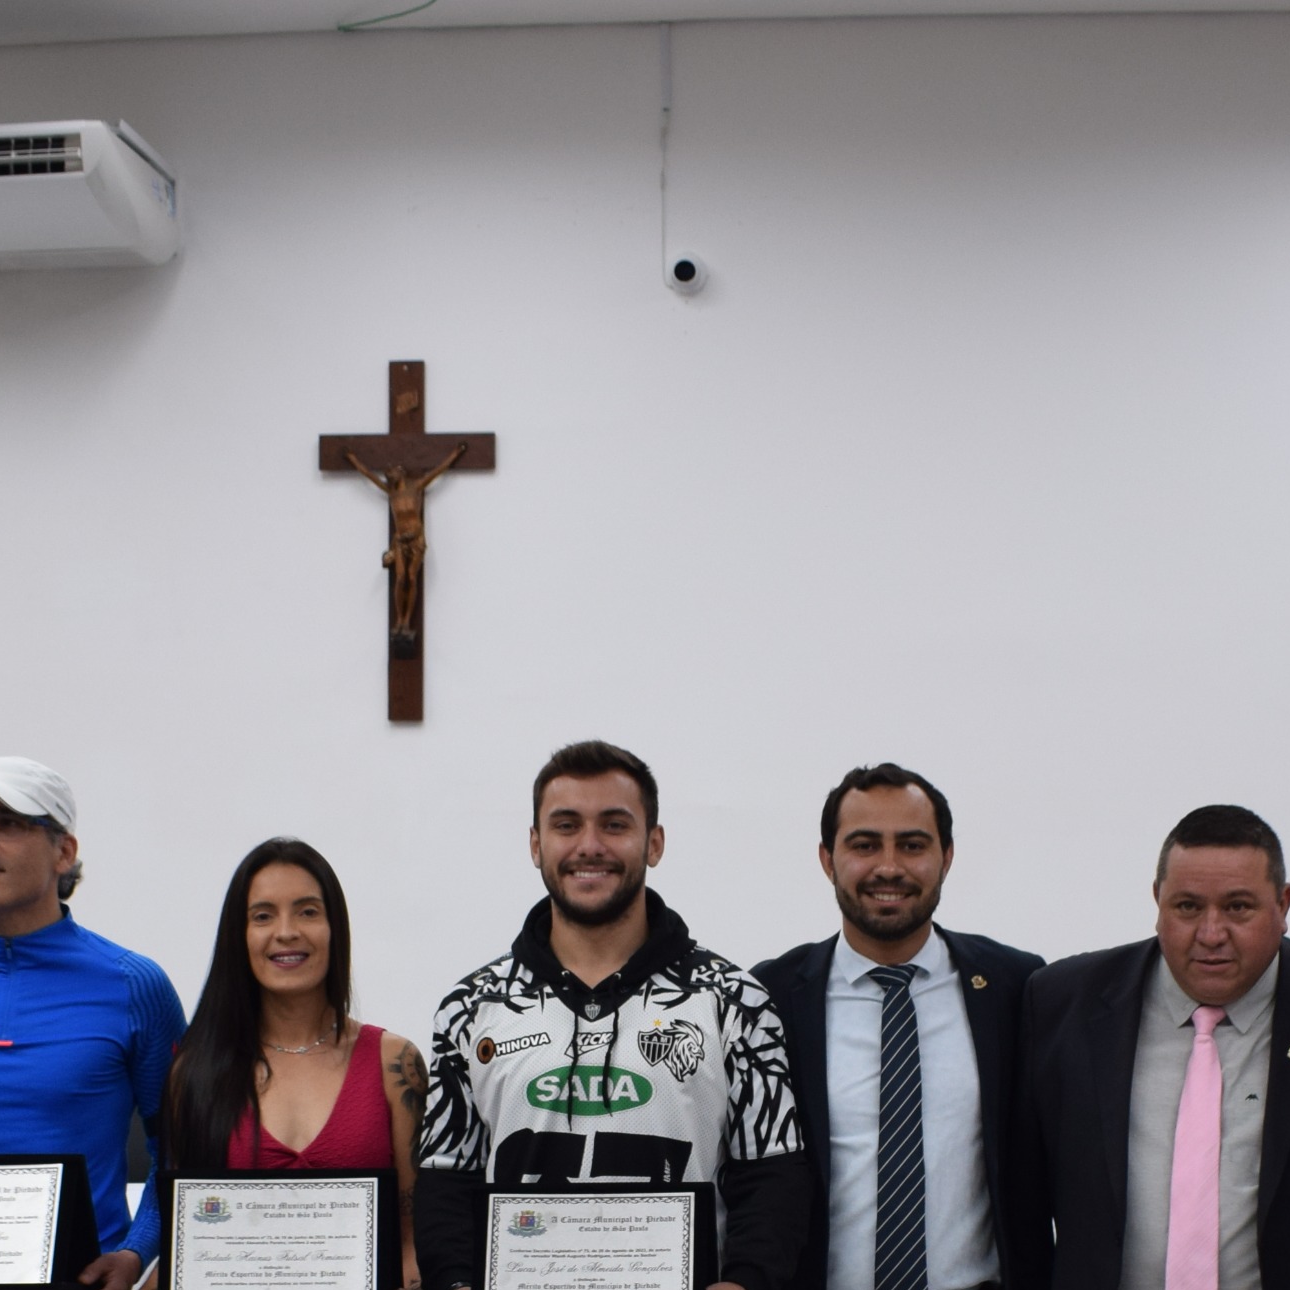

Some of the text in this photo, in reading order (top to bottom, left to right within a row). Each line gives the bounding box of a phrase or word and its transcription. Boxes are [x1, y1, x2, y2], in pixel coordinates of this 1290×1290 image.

[496, 1033, 550, 1056] HINOVA
[643, 1035, 668, 1043] CAM
[536, 1075, 640, 1102] SADA
[245, 1202, 275, 1210] Câmara
[645, 1215, 676, 1223] Piedade
[505, 1262, 673, 1276] Lucas José de Almeida Gonçalves
